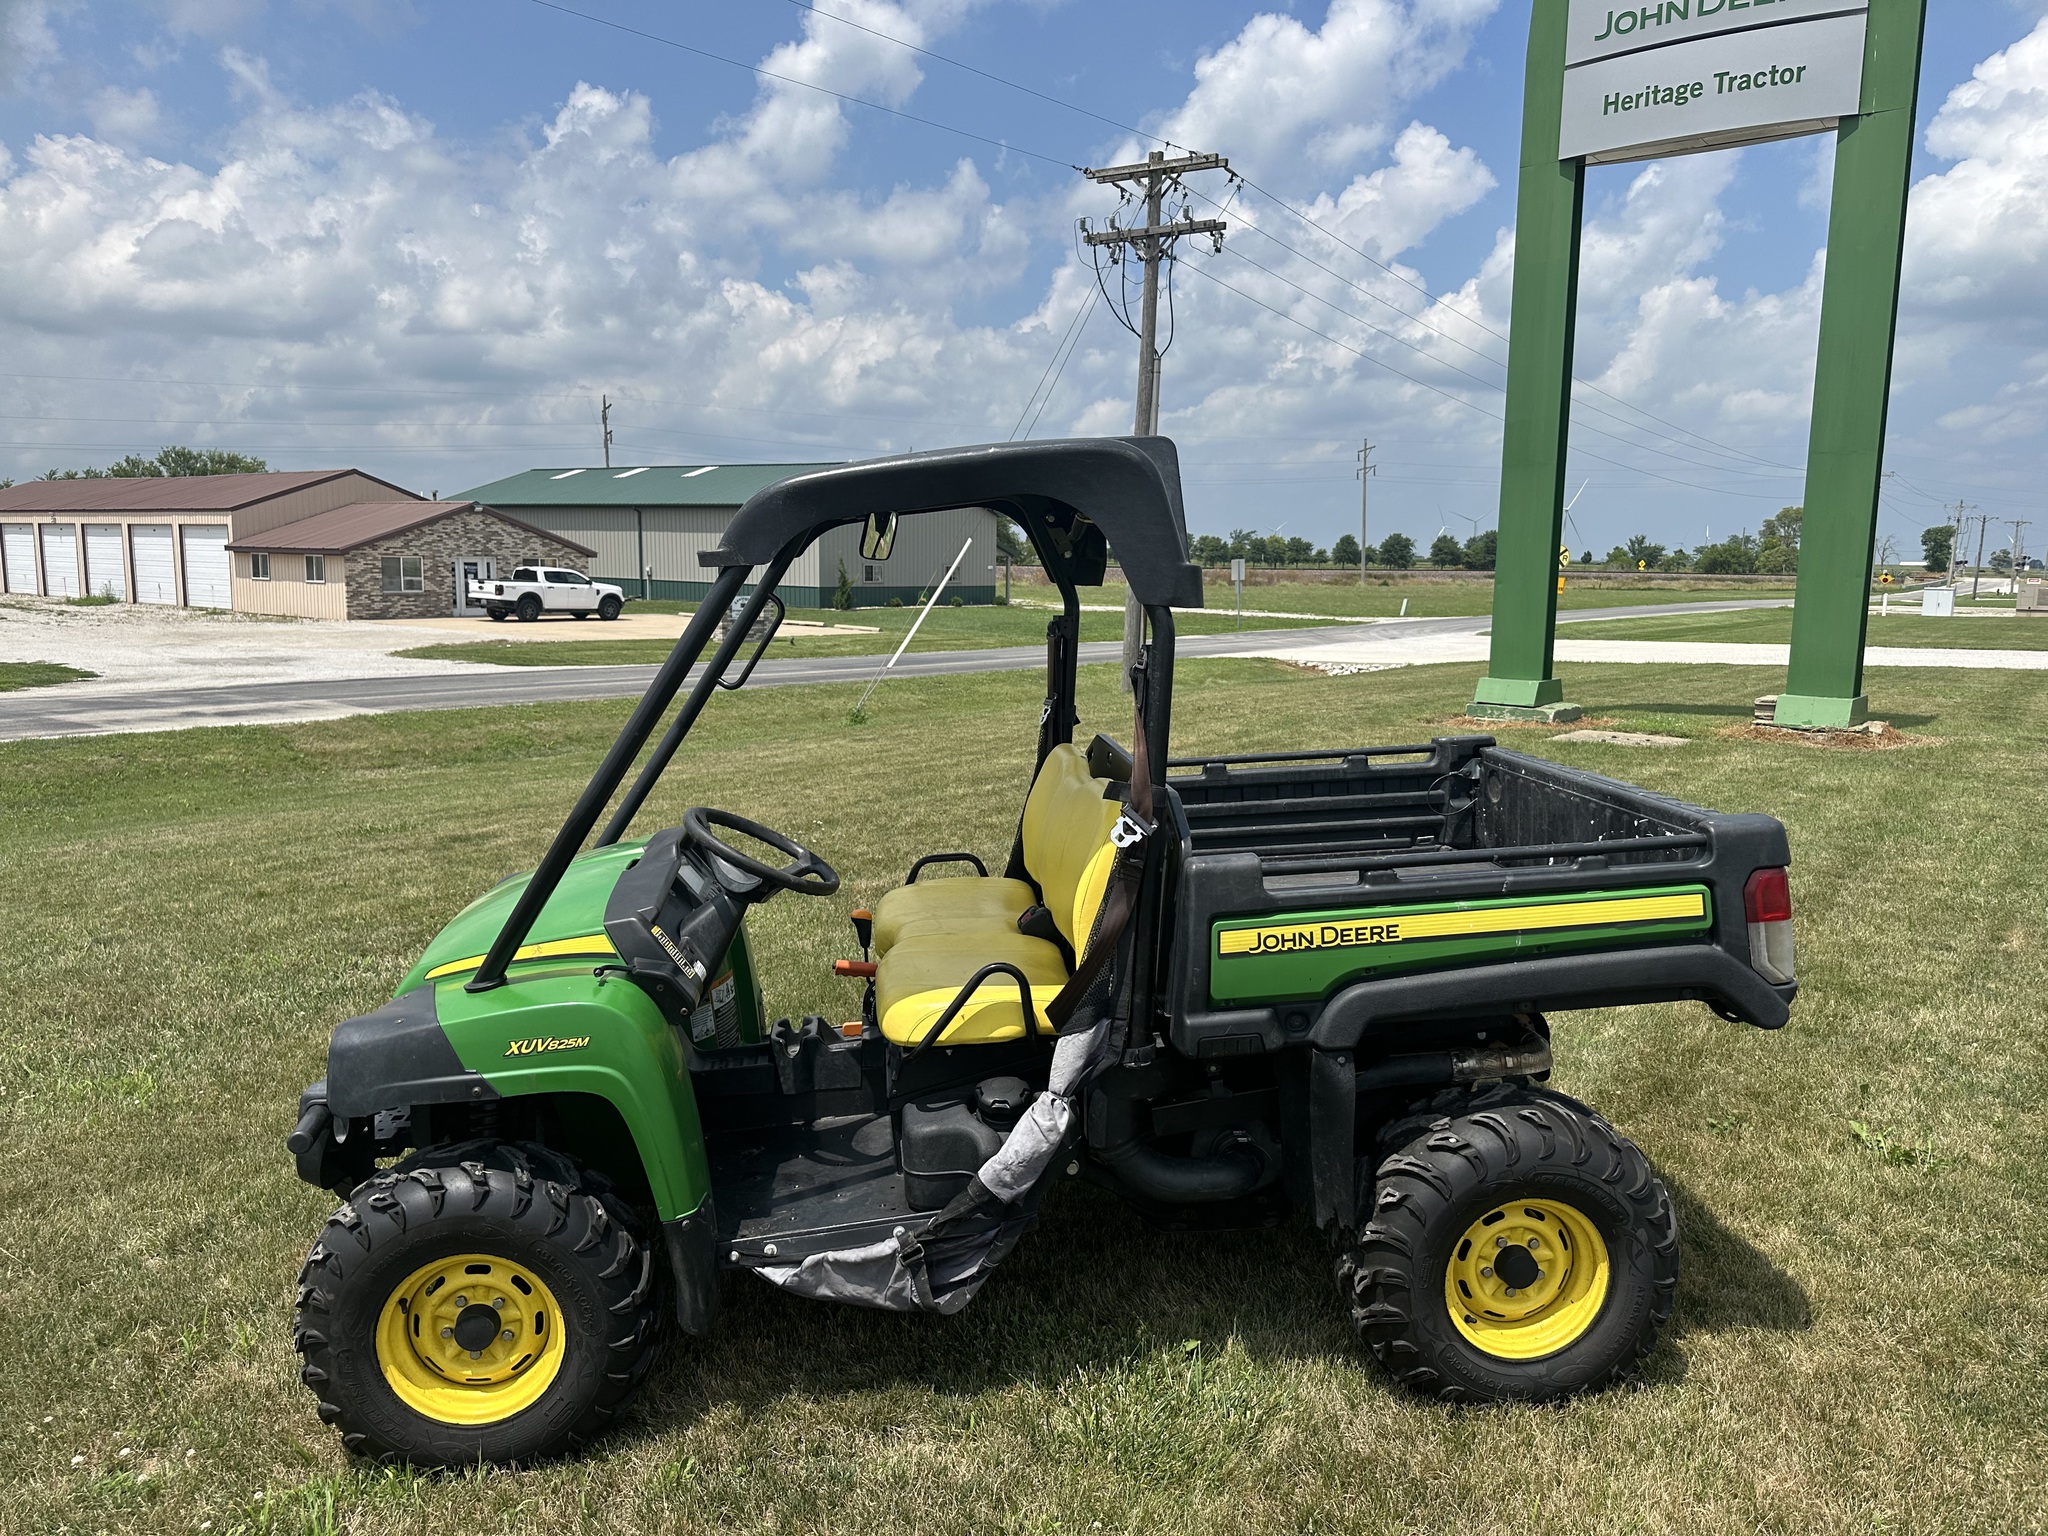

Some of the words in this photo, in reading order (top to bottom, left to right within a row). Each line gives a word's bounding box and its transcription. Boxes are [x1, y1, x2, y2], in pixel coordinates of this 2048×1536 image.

[1594, 0, 1689, 41] JOHN
[1603, 81, 1703, 115] Heritage
[1713, 65, 1806, 94] Tractor
[1249, 932, 1314, 952] JOHN
[1320, 924, 1400, 945] DEERE
[503, 1036, 591, 1057] XUV825M
